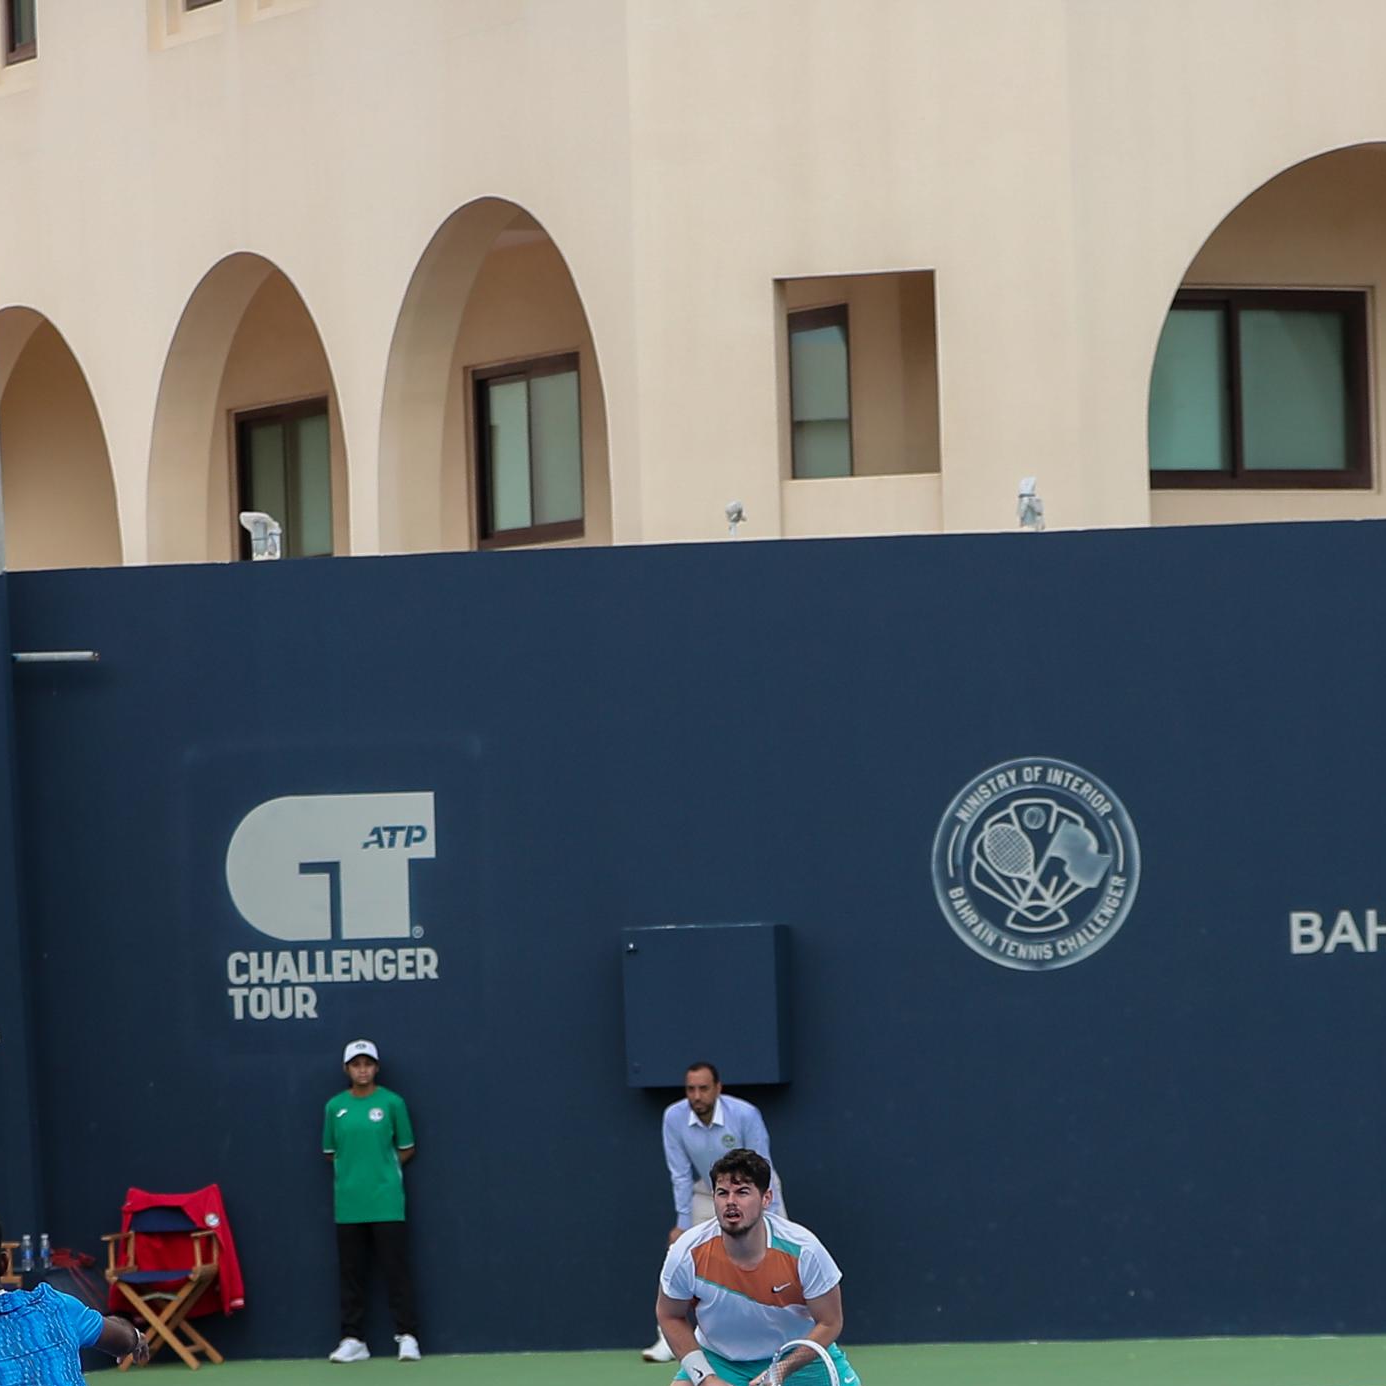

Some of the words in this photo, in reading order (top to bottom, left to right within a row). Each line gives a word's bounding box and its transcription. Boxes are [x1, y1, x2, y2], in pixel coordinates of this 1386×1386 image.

[955, 768, 1017, 823] MINISTRY
[1023, 766, 1043, 782] OF
[1046, 767, 1113, 817] INTERIOR
[362, 825, 428, 849] ATP
[948, 885, 997, 948] BAHRAIN
[999, 937, 1054, 960] TENNIS
[1056, 875, 1126, 957] CHALLENGER
[227, 947, 439, 985] CHALLENGER
[227, 985, 318, 1020] TOUR
